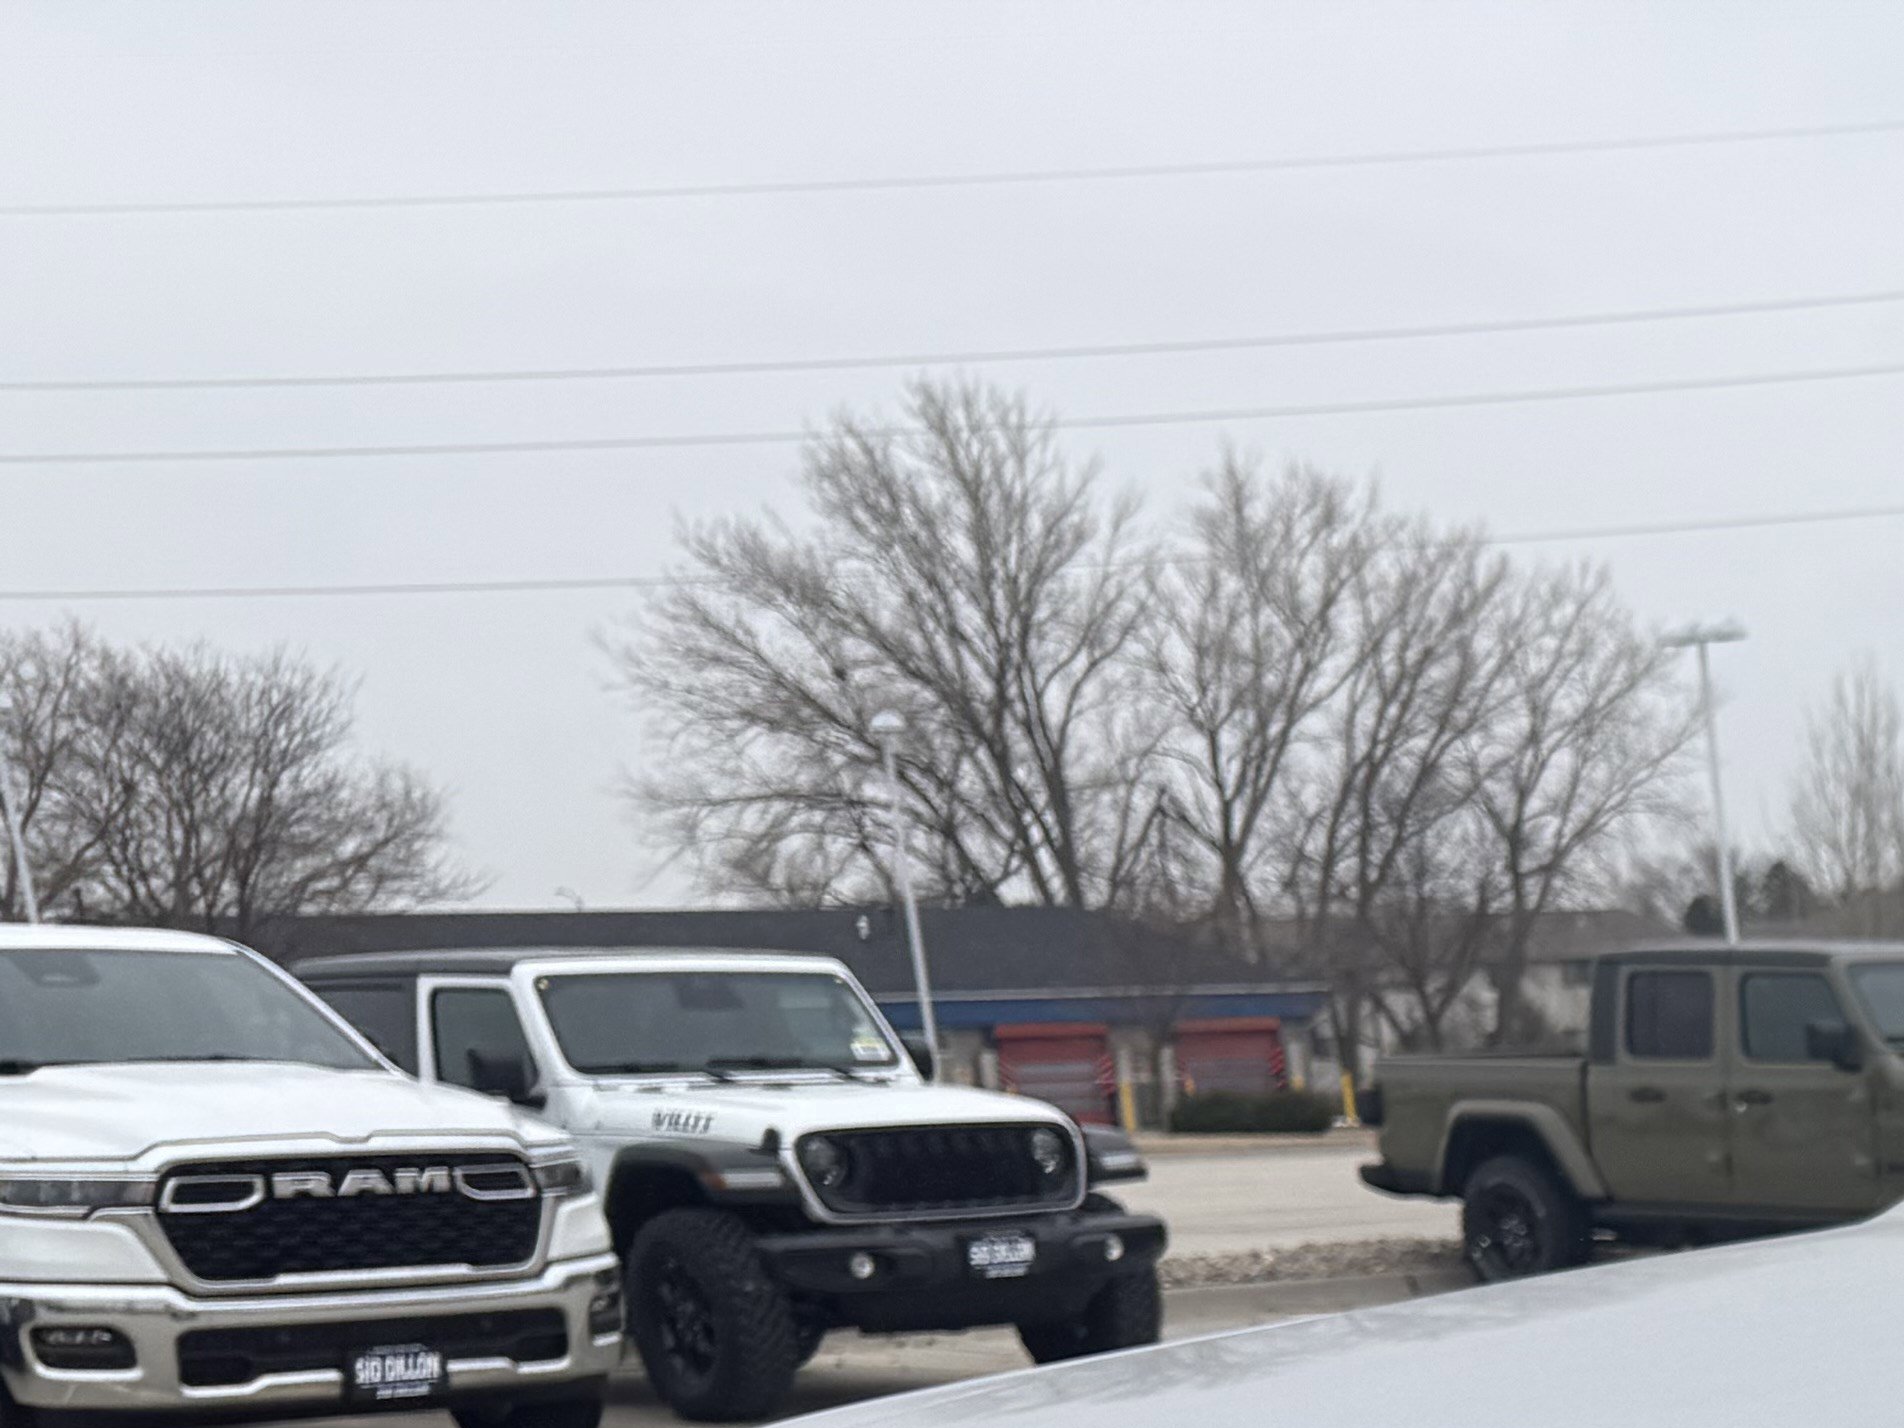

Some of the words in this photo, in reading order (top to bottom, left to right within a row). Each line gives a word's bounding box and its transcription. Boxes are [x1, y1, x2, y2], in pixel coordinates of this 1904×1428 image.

[272, 1166, 450, 1199] RAM
[354, 1355, 382, 1385] SID
[385, 1351, 442, 1382] DILLON
